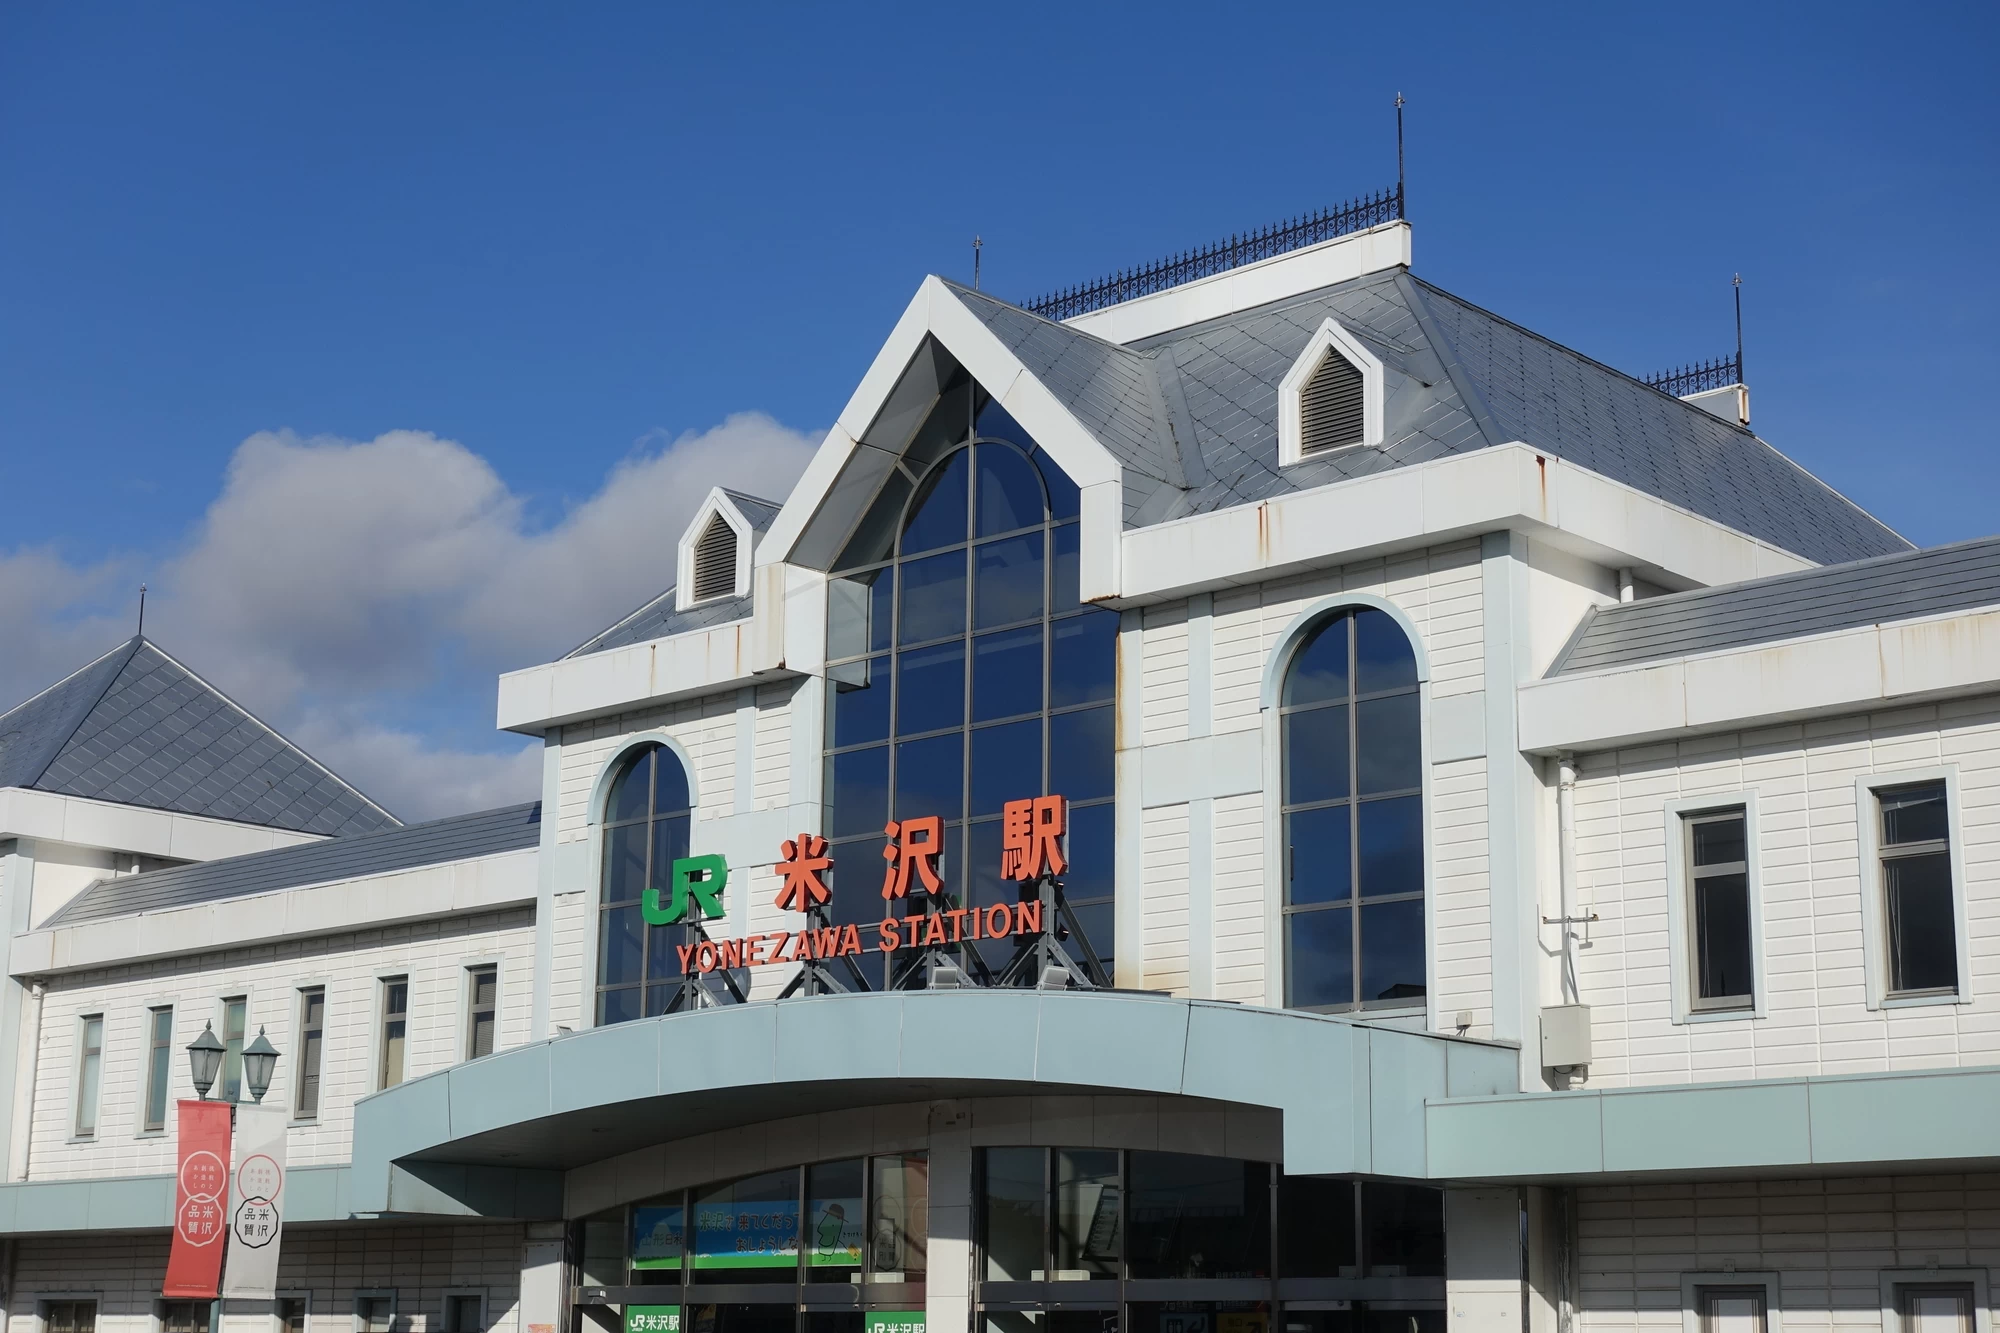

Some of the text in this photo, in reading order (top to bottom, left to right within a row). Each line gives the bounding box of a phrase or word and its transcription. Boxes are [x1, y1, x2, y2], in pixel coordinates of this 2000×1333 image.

[642, 794, 1068, 926] JR 米沢駅
[676, 899, 1043, 975] YONEZAWA STATION
[630, 1314, 679, 1331] JR 米沢駅
[887, 1322, 924, 1333] 米沢駅
